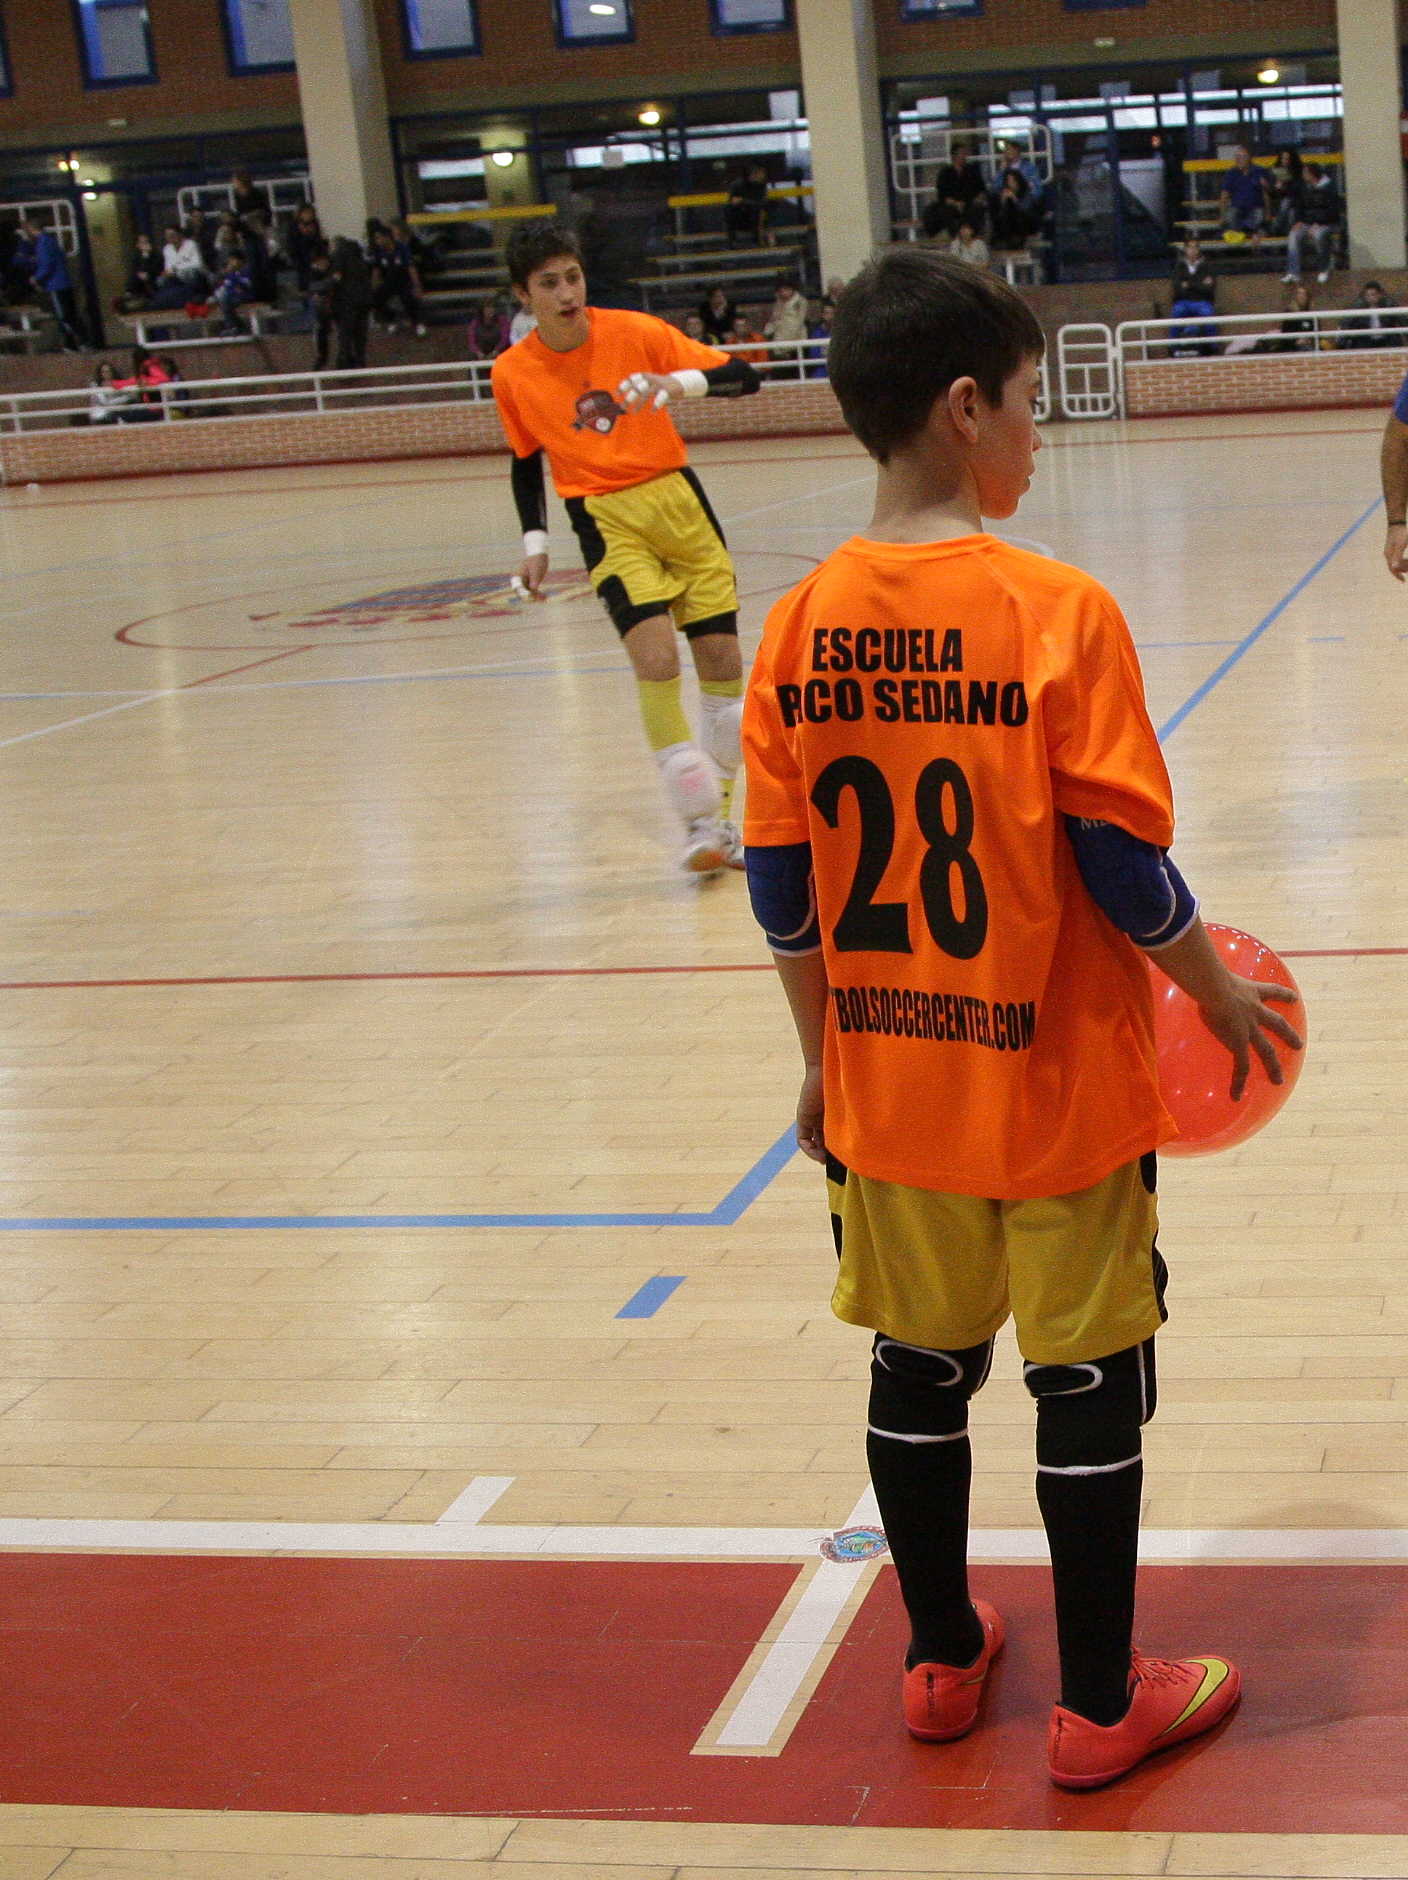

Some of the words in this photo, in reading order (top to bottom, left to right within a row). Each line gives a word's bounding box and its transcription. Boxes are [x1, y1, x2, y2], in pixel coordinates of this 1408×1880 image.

[812, 627, 963, 673] ESCUELA
[873, 679, 1029, 727] SEDANO
[810, 755, 989, 960] 28
[829, 986, 1036, 1051] BOLSOCCERCENTER.COM
